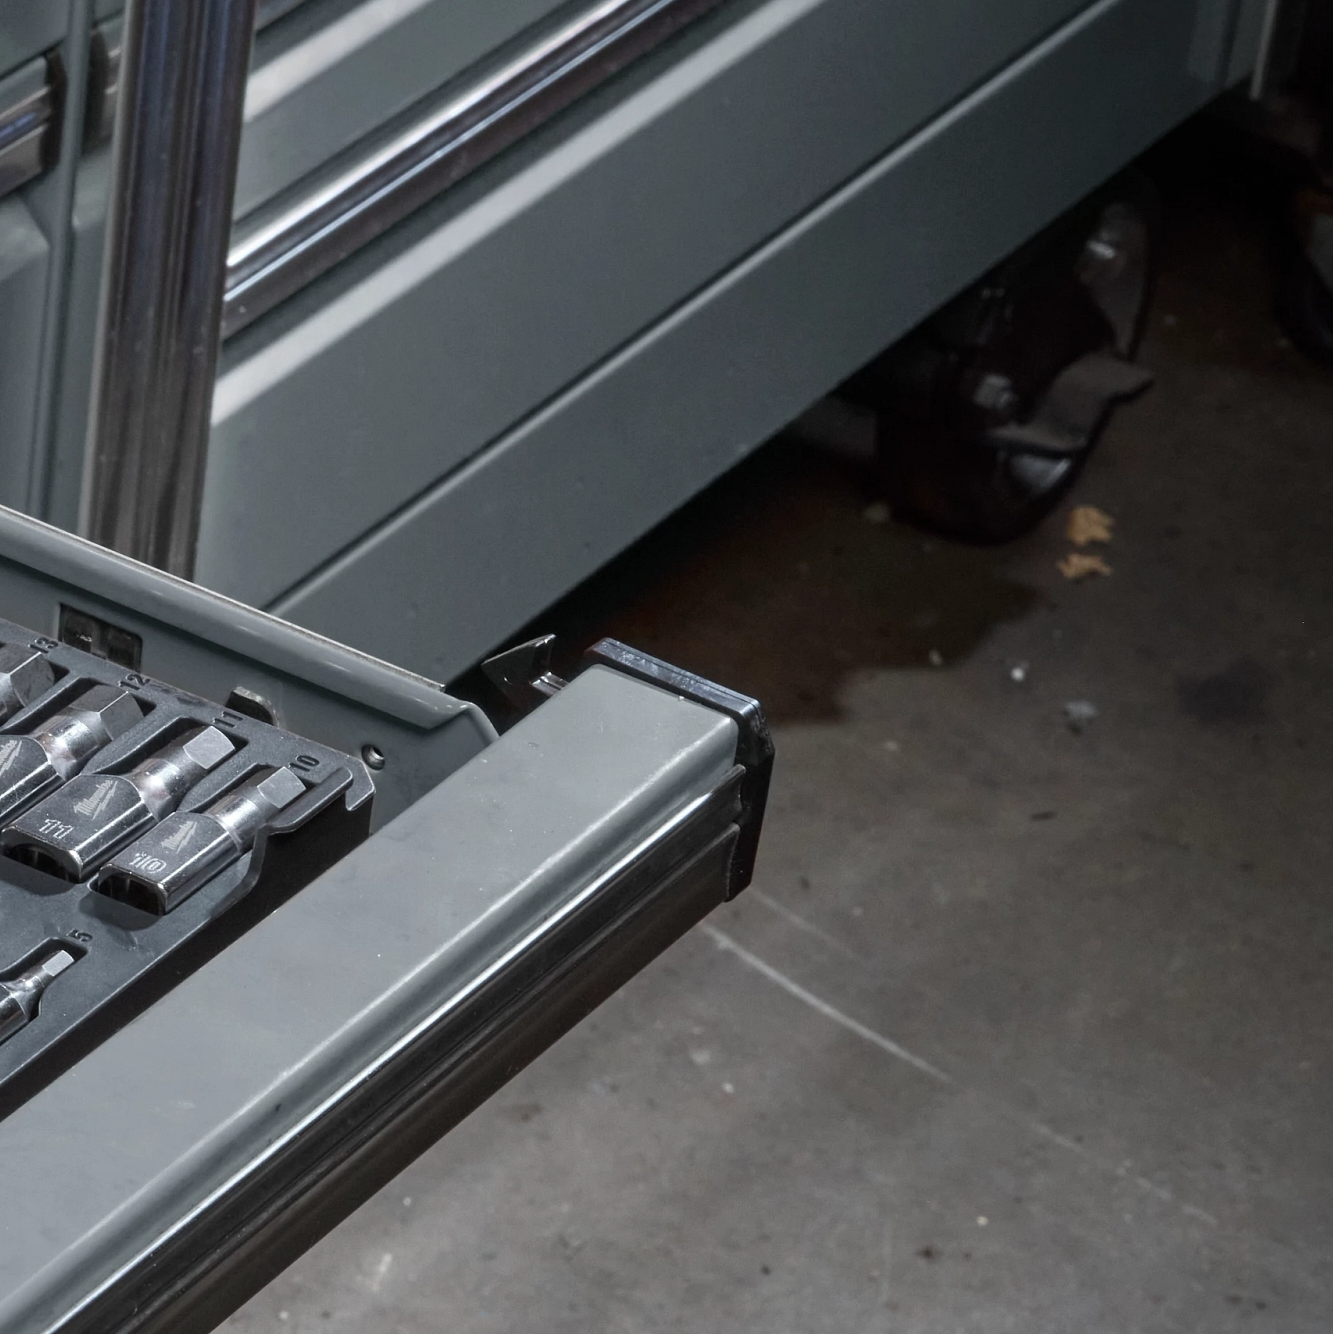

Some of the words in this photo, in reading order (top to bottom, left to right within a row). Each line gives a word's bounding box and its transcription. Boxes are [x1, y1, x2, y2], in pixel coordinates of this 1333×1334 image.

[27, 636, 59, 654] 13
[118, 673, 151, 691] 12
[212, 710, 244, 729] 11
[288, 754, 321, 773] 10
[73, 779, 113, 816] Milwaukee
[38, 818, 73, 840] 11
[160, 820, 194, 850] Milwaukee
[128, 852, 168, 874] 10
[66, 928, 94, 943] 5
